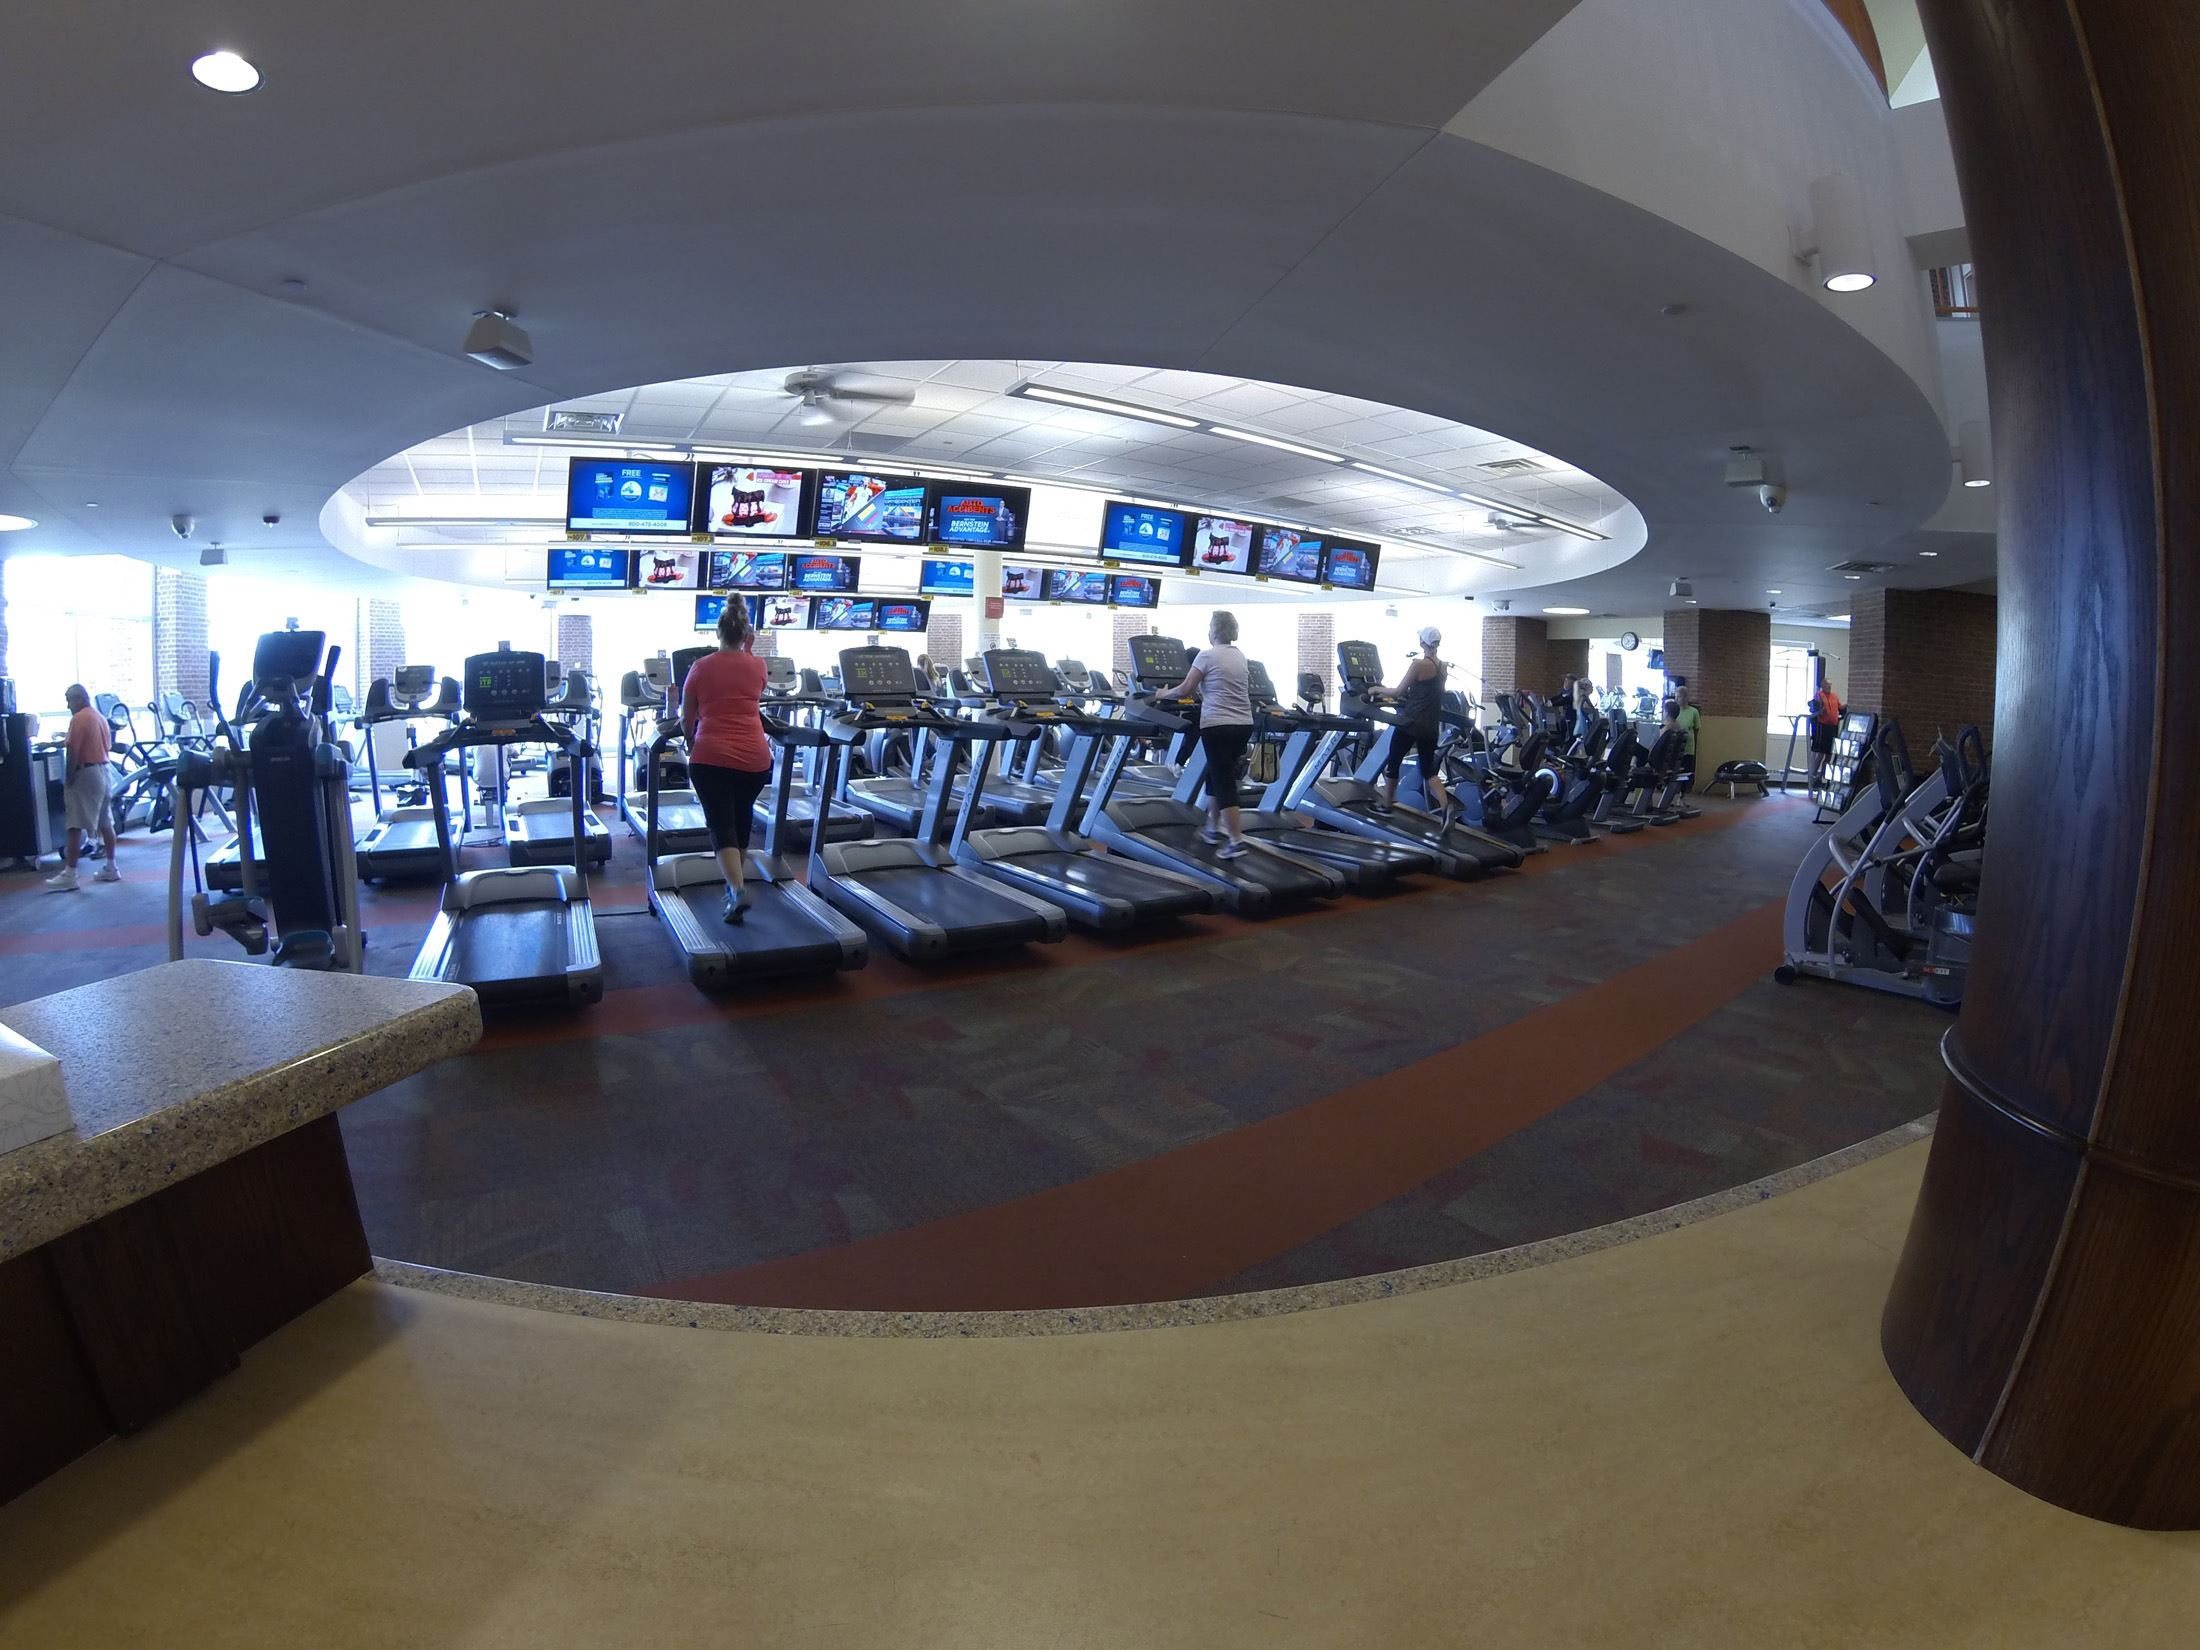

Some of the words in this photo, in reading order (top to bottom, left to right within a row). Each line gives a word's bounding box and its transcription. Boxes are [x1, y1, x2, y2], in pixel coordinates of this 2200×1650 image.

[621, 469, 642, 477] FREE
[961, 499, 984, 507] AUTO
[947, 505, 996, 514] ACCIDENTS
